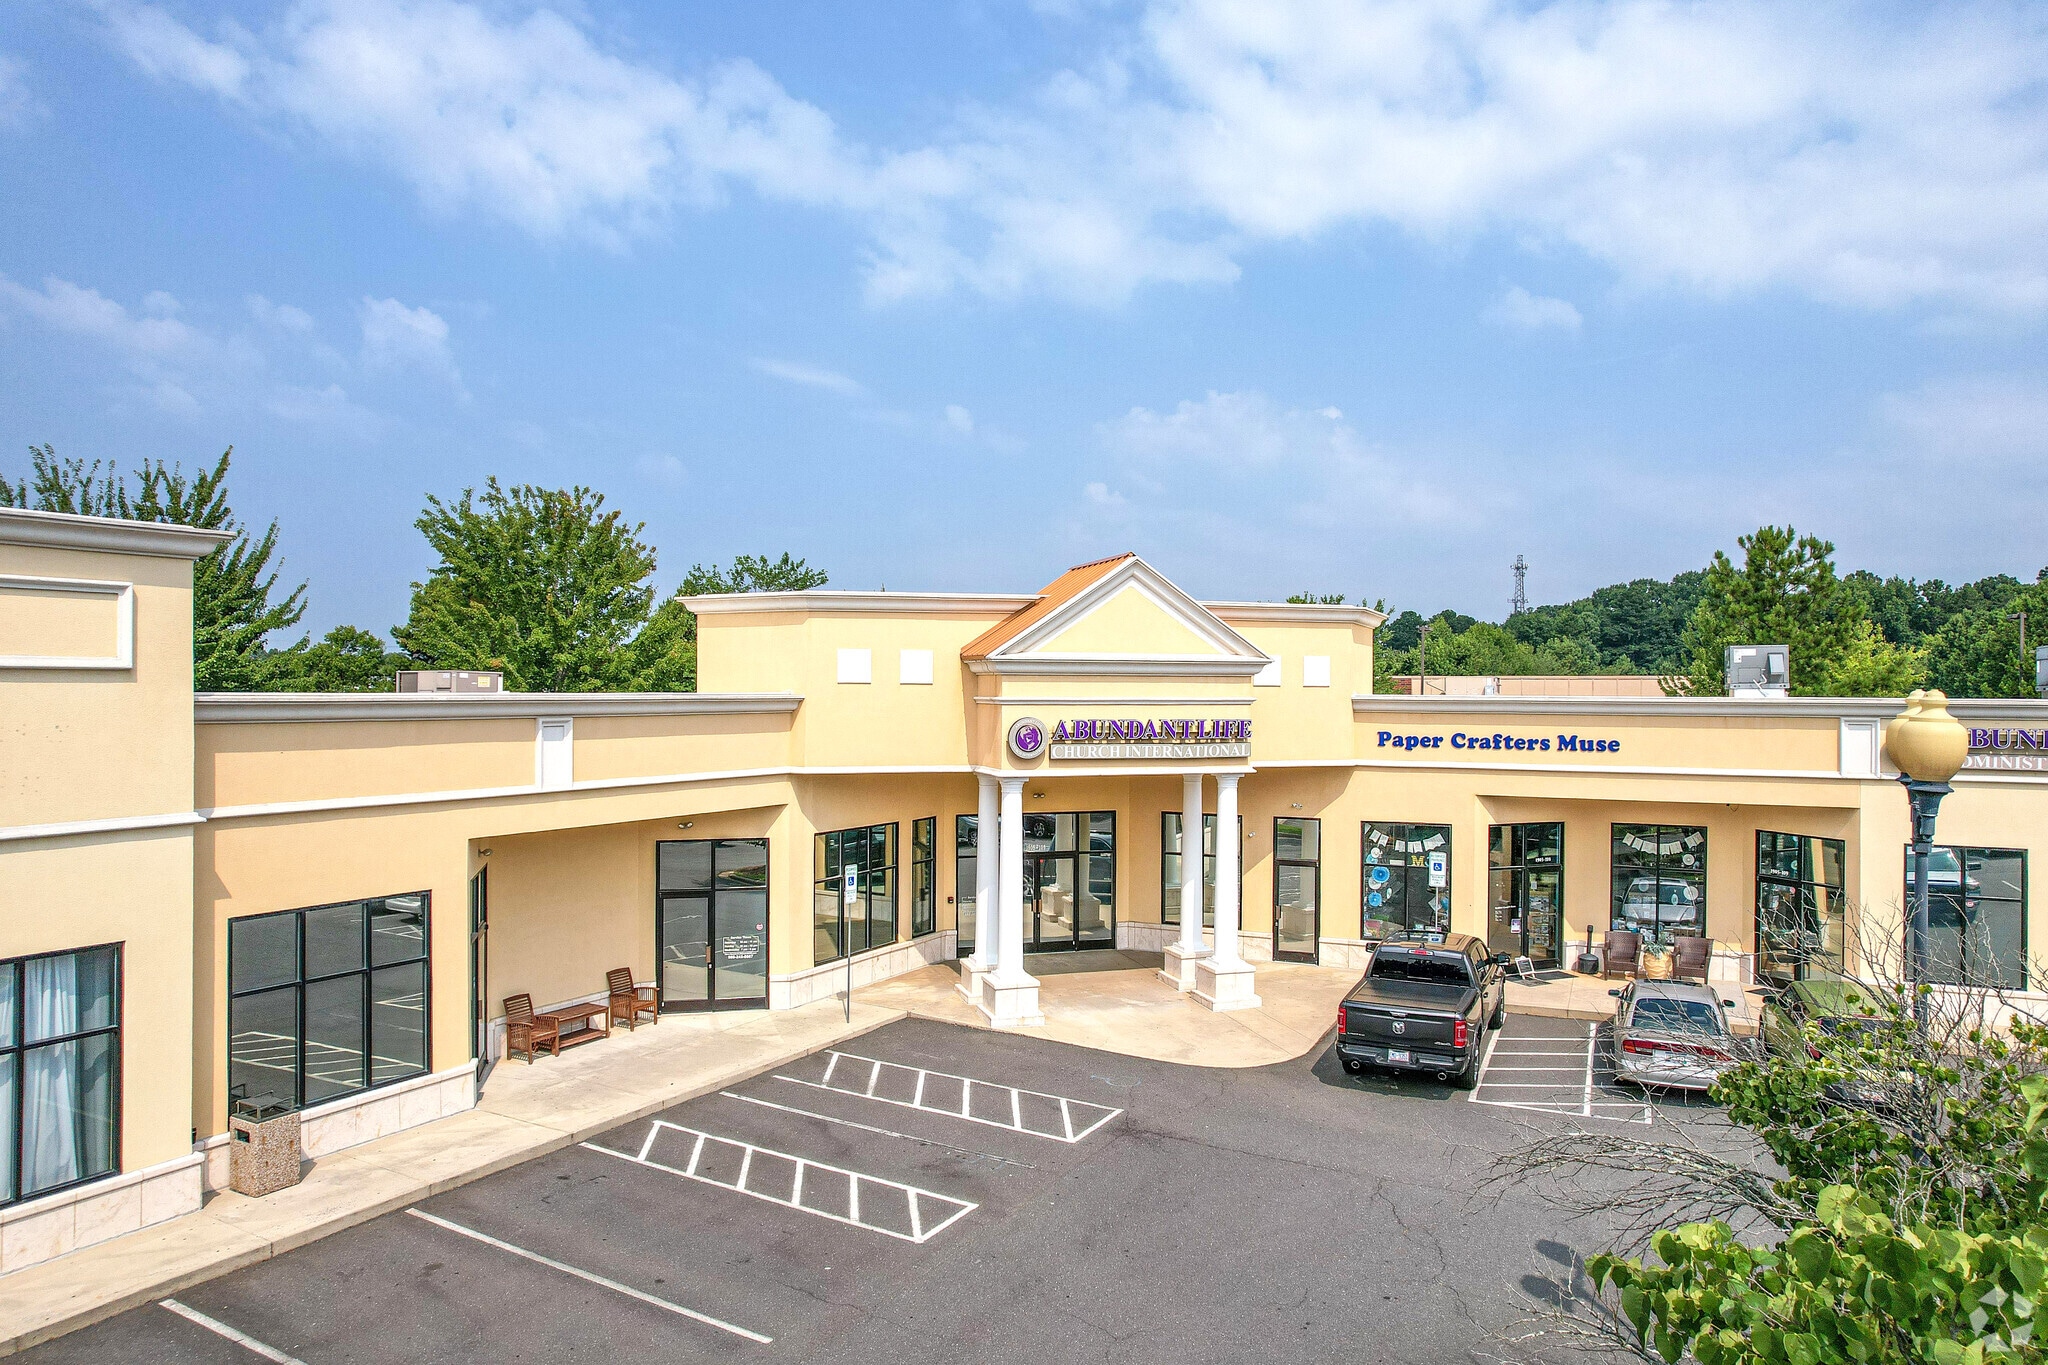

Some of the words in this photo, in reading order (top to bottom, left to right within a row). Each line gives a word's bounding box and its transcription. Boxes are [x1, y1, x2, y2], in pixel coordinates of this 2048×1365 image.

[1377, 731, 1444, 750] Paper
[1451, 732, 1551, 751] Crafters
[1557, 734, 1621, 753] Muse
[1967, 727, 2048, 750] BUN
[1052, 744, 1121, 759] CHURCH
[1125, 743, 1251, 759] INTERNATIONAL
[1960, 755, 2048, 769] DMINIST
[1411, 855, 1425, 866] M
